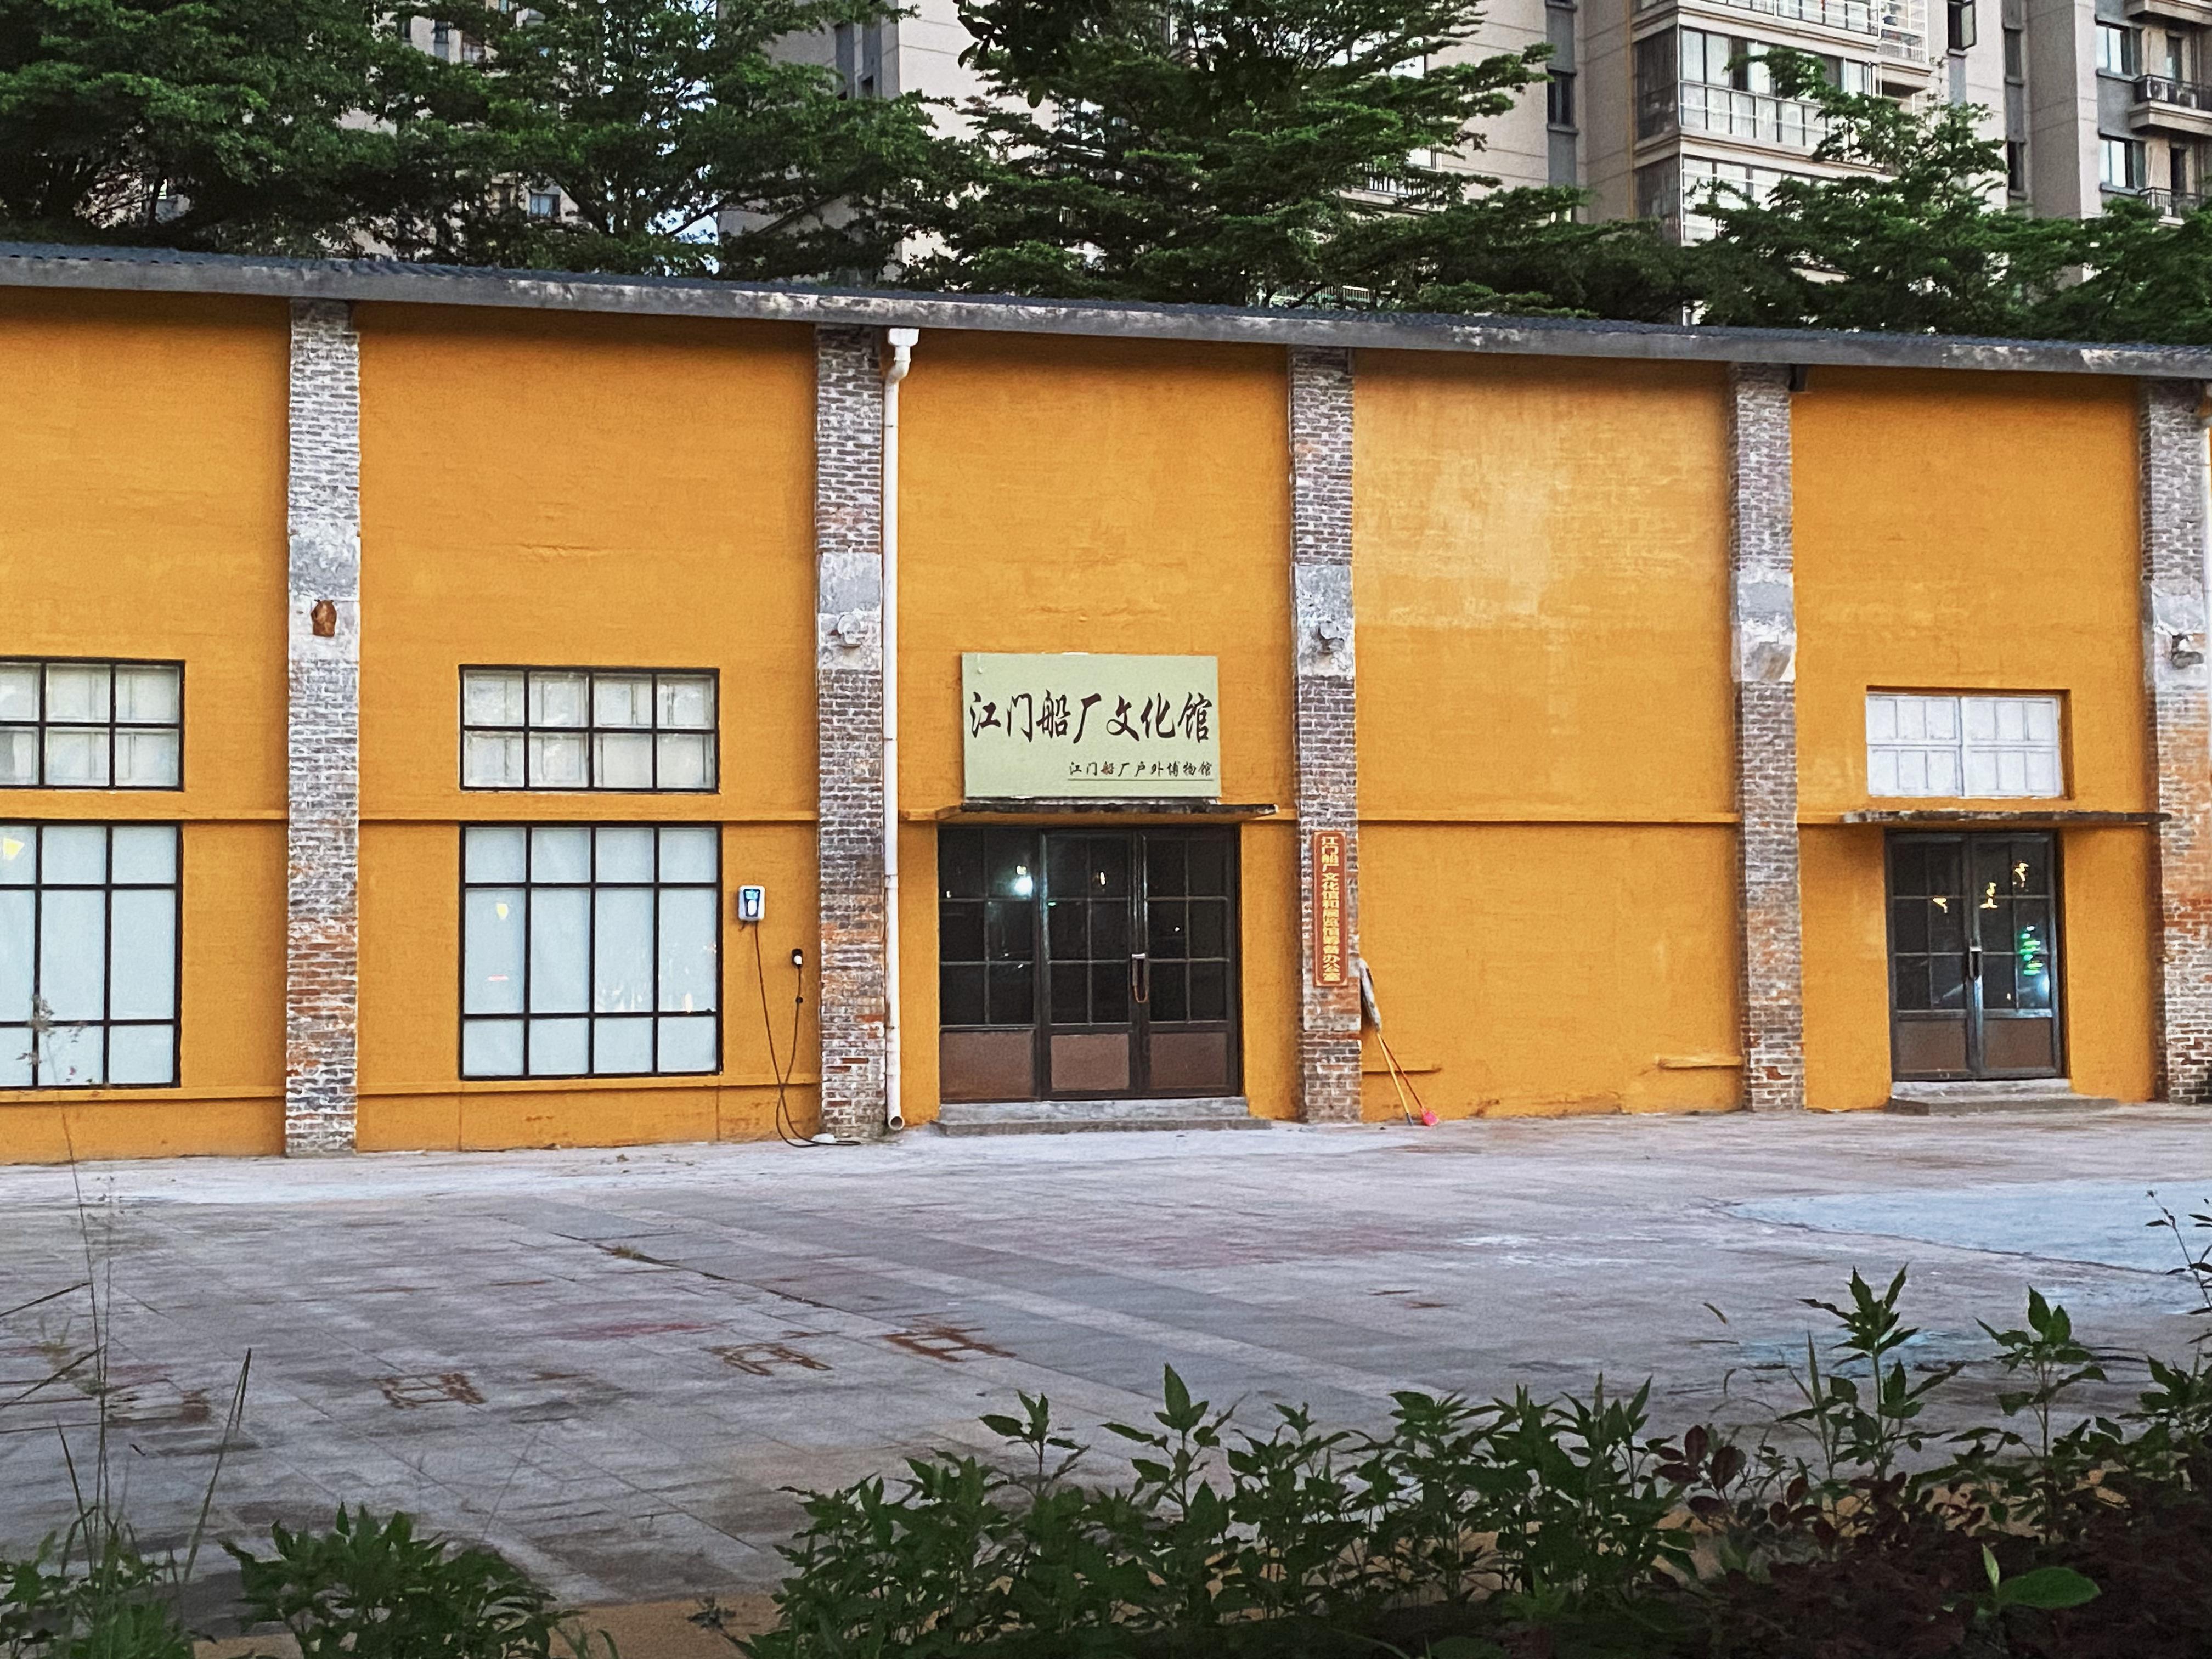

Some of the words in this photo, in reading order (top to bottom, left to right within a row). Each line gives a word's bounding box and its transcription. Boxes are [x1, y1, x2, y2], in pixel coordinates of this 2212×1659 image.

[969, 689, 1212, 744] 江门船厂文化馆
[1069, 761, 1212, 777] 江门船厂户外博物馆
